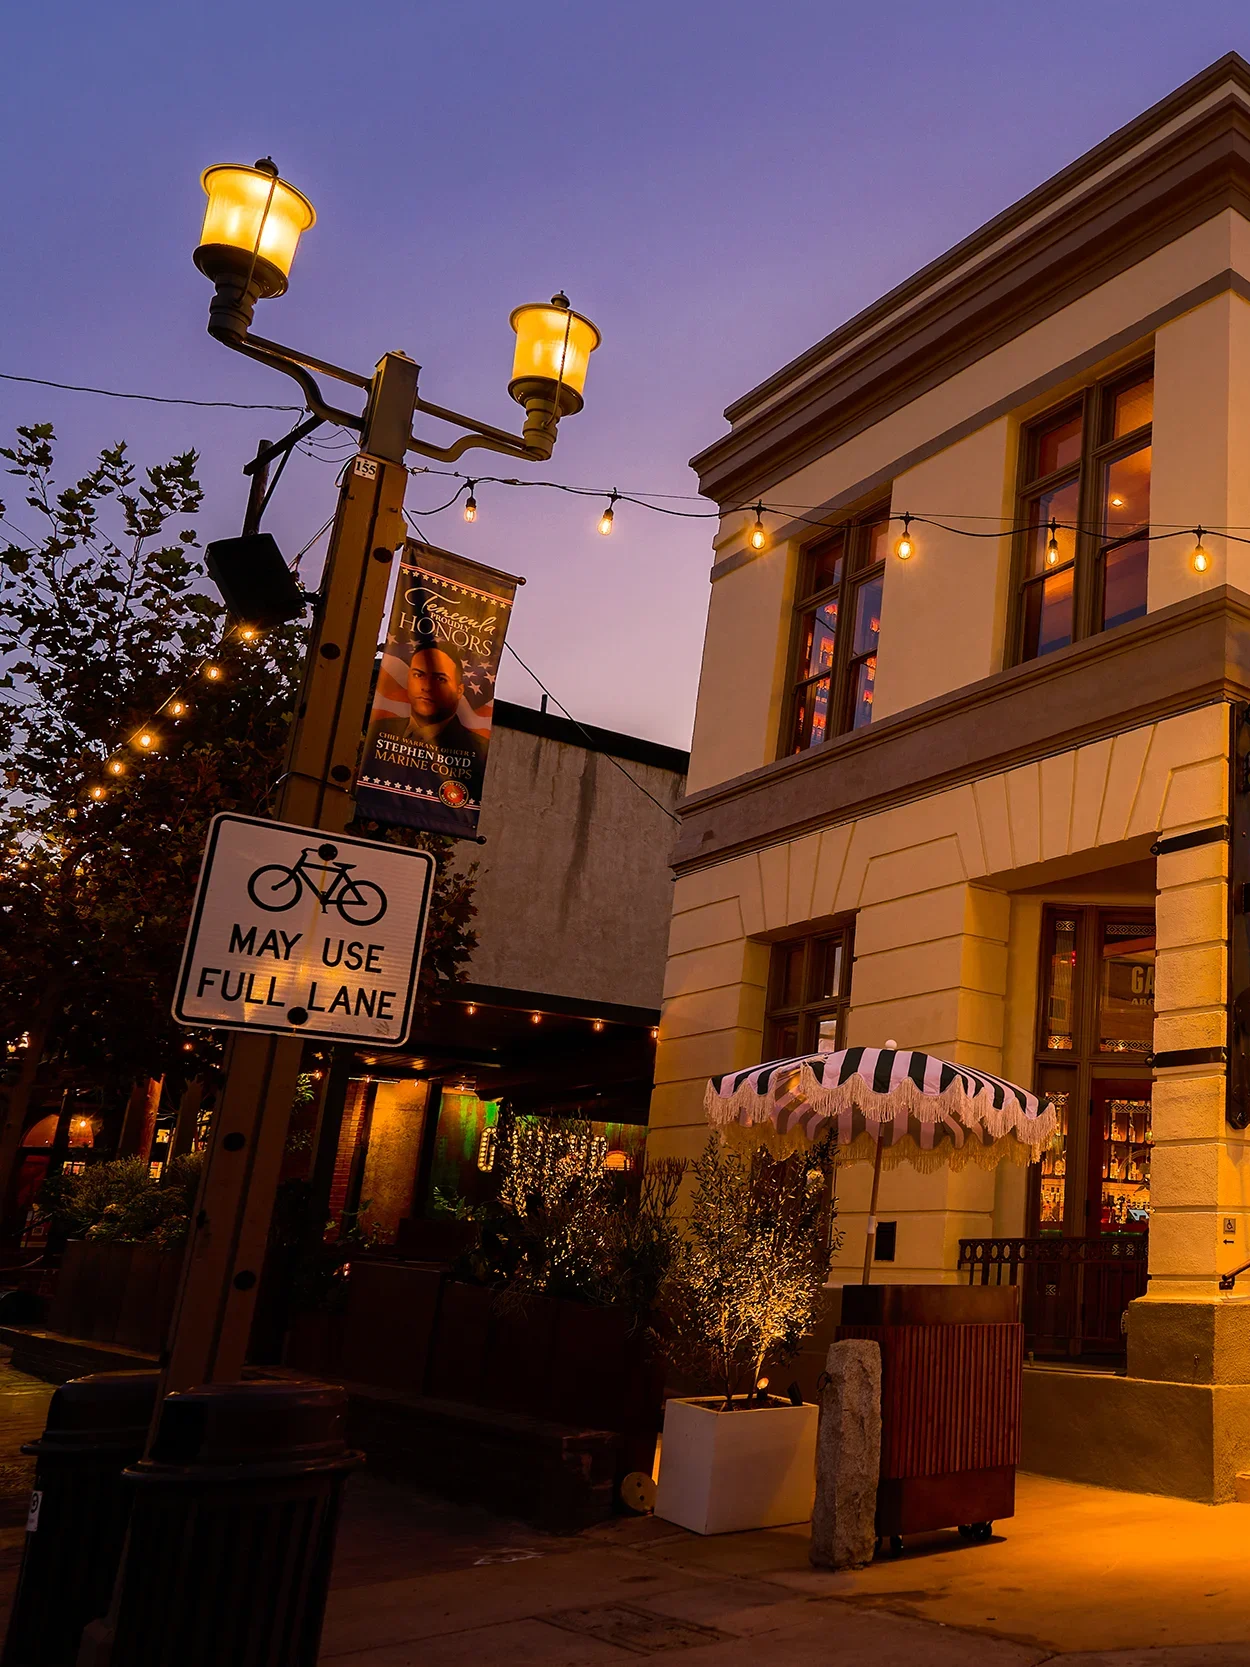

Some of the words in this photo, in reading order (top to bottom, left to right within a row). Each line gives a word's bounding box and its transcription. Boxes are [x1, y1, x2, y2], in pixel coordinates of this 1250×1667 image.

[356, 461, 376, 474] 155
[404, 586, 497, 636] Temecula
[430, 612, 471, 632] PROUDLY
[399, 611, 493, 657] HONORS
[376, 738, 435, 760] STEPHEN
[437, 753, 471, 768] BOYD
[402, 737, 439, 752] WARRANT
[374, 750, 429, 771] MARINE
[430, 762, 472, 779] CORPS
[228, 923, 304, 961] MAY
[321, 937, 385, 974] USE
[196, 966, 286, 1008] FULL
[307, 981, 397, 1020] LANE
